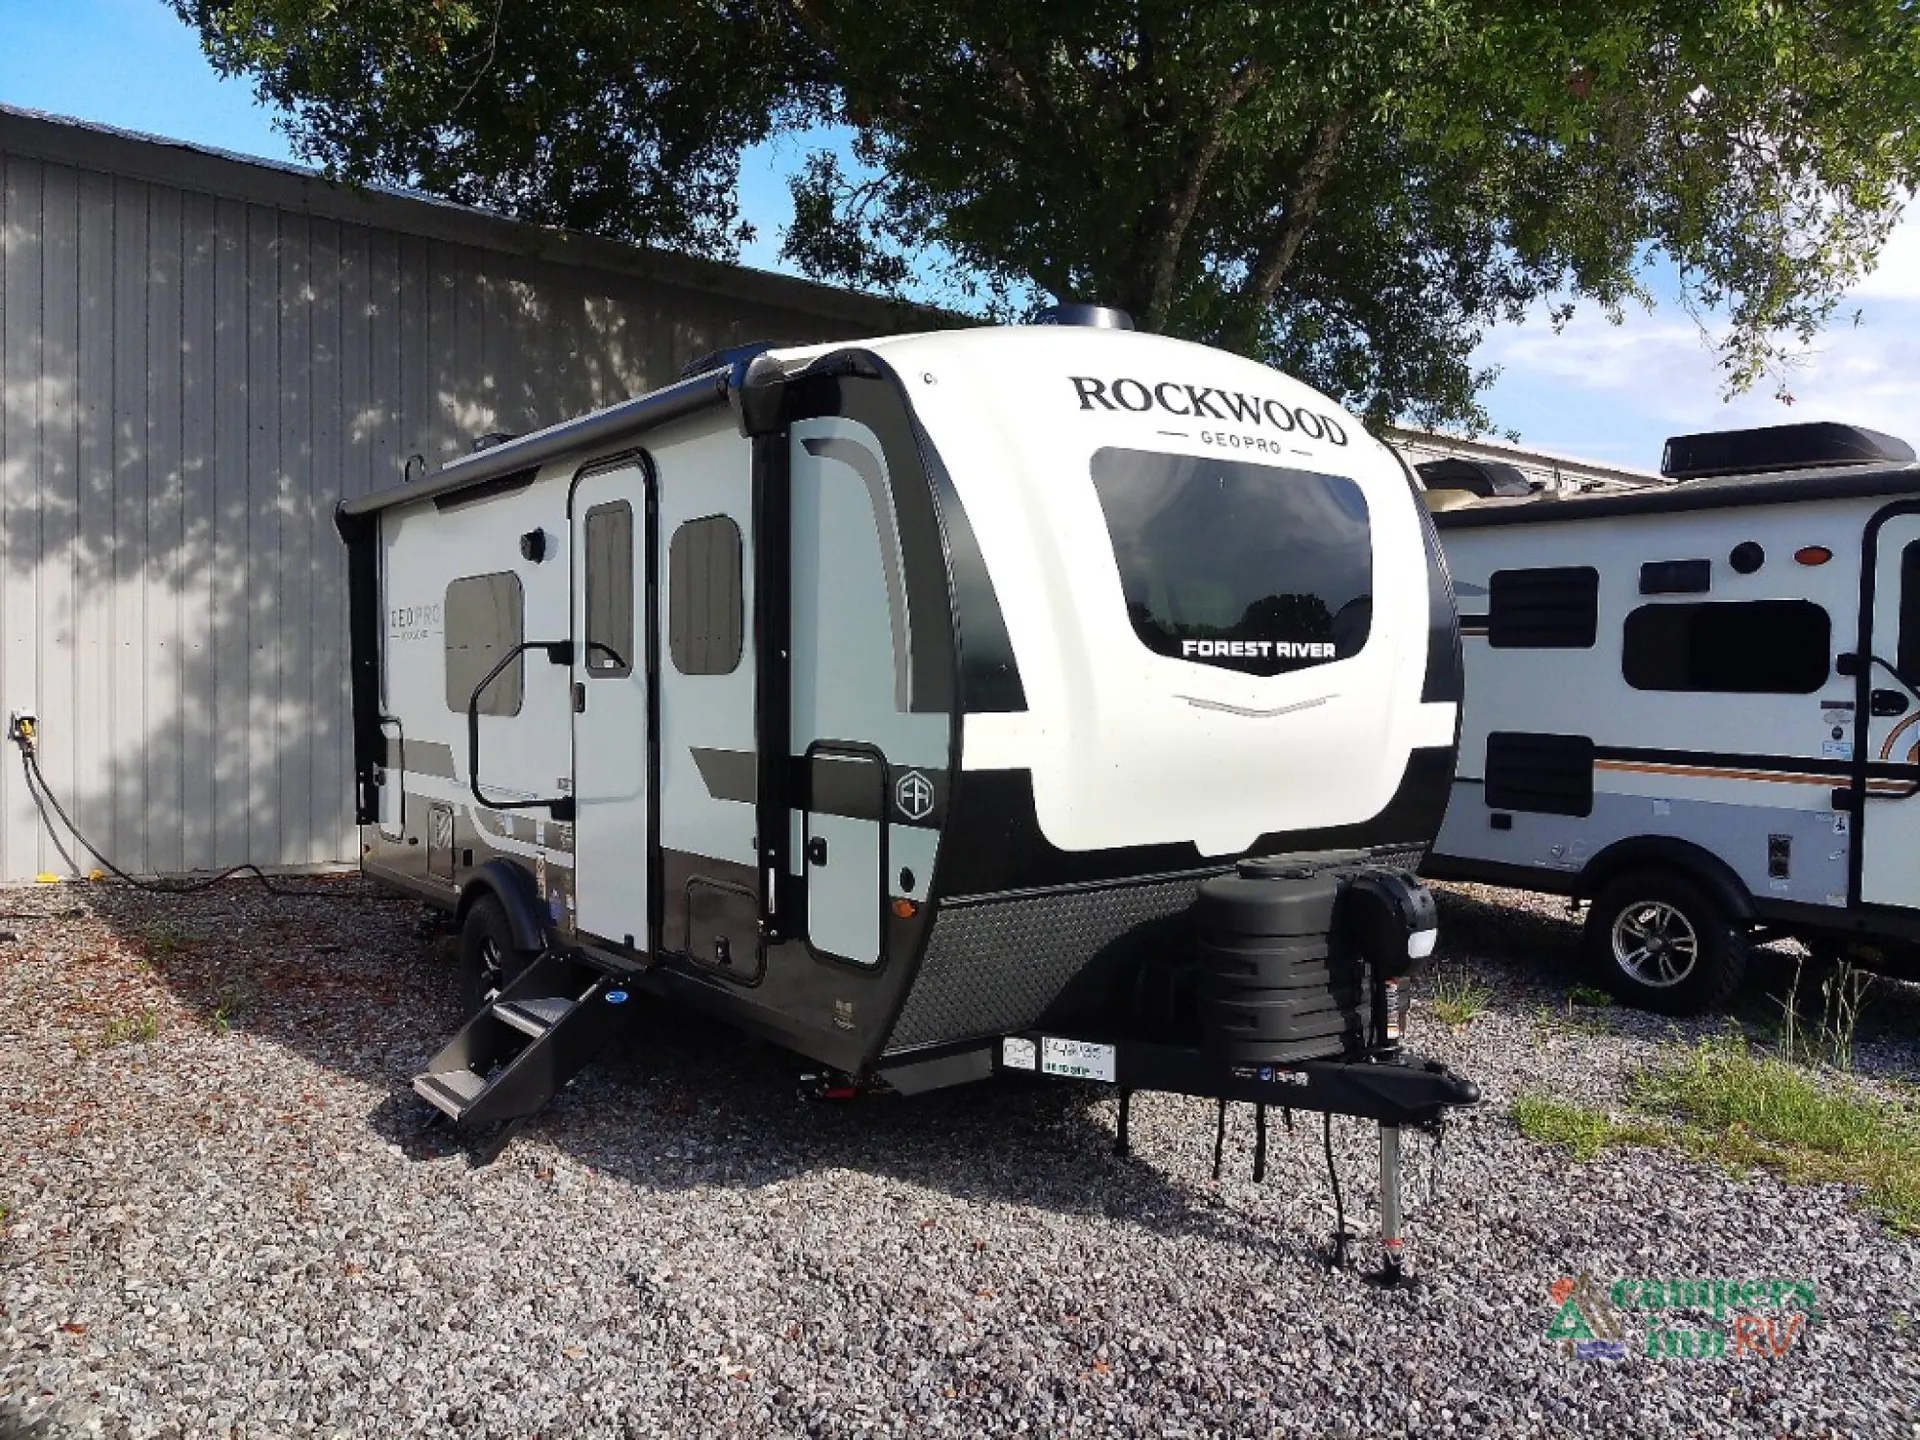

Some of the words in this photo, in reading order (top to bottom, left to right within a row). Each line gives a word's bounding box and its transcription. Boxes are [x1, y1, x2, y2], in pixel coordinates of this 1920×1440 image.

[1067, 376, 1349, 447] ROCKWOOD
[1200, 430, 1282, 455] GEOPRO
[1182, 640, 1272, 657] FOREST
[1276, 642, 1336, 658] RIVER
